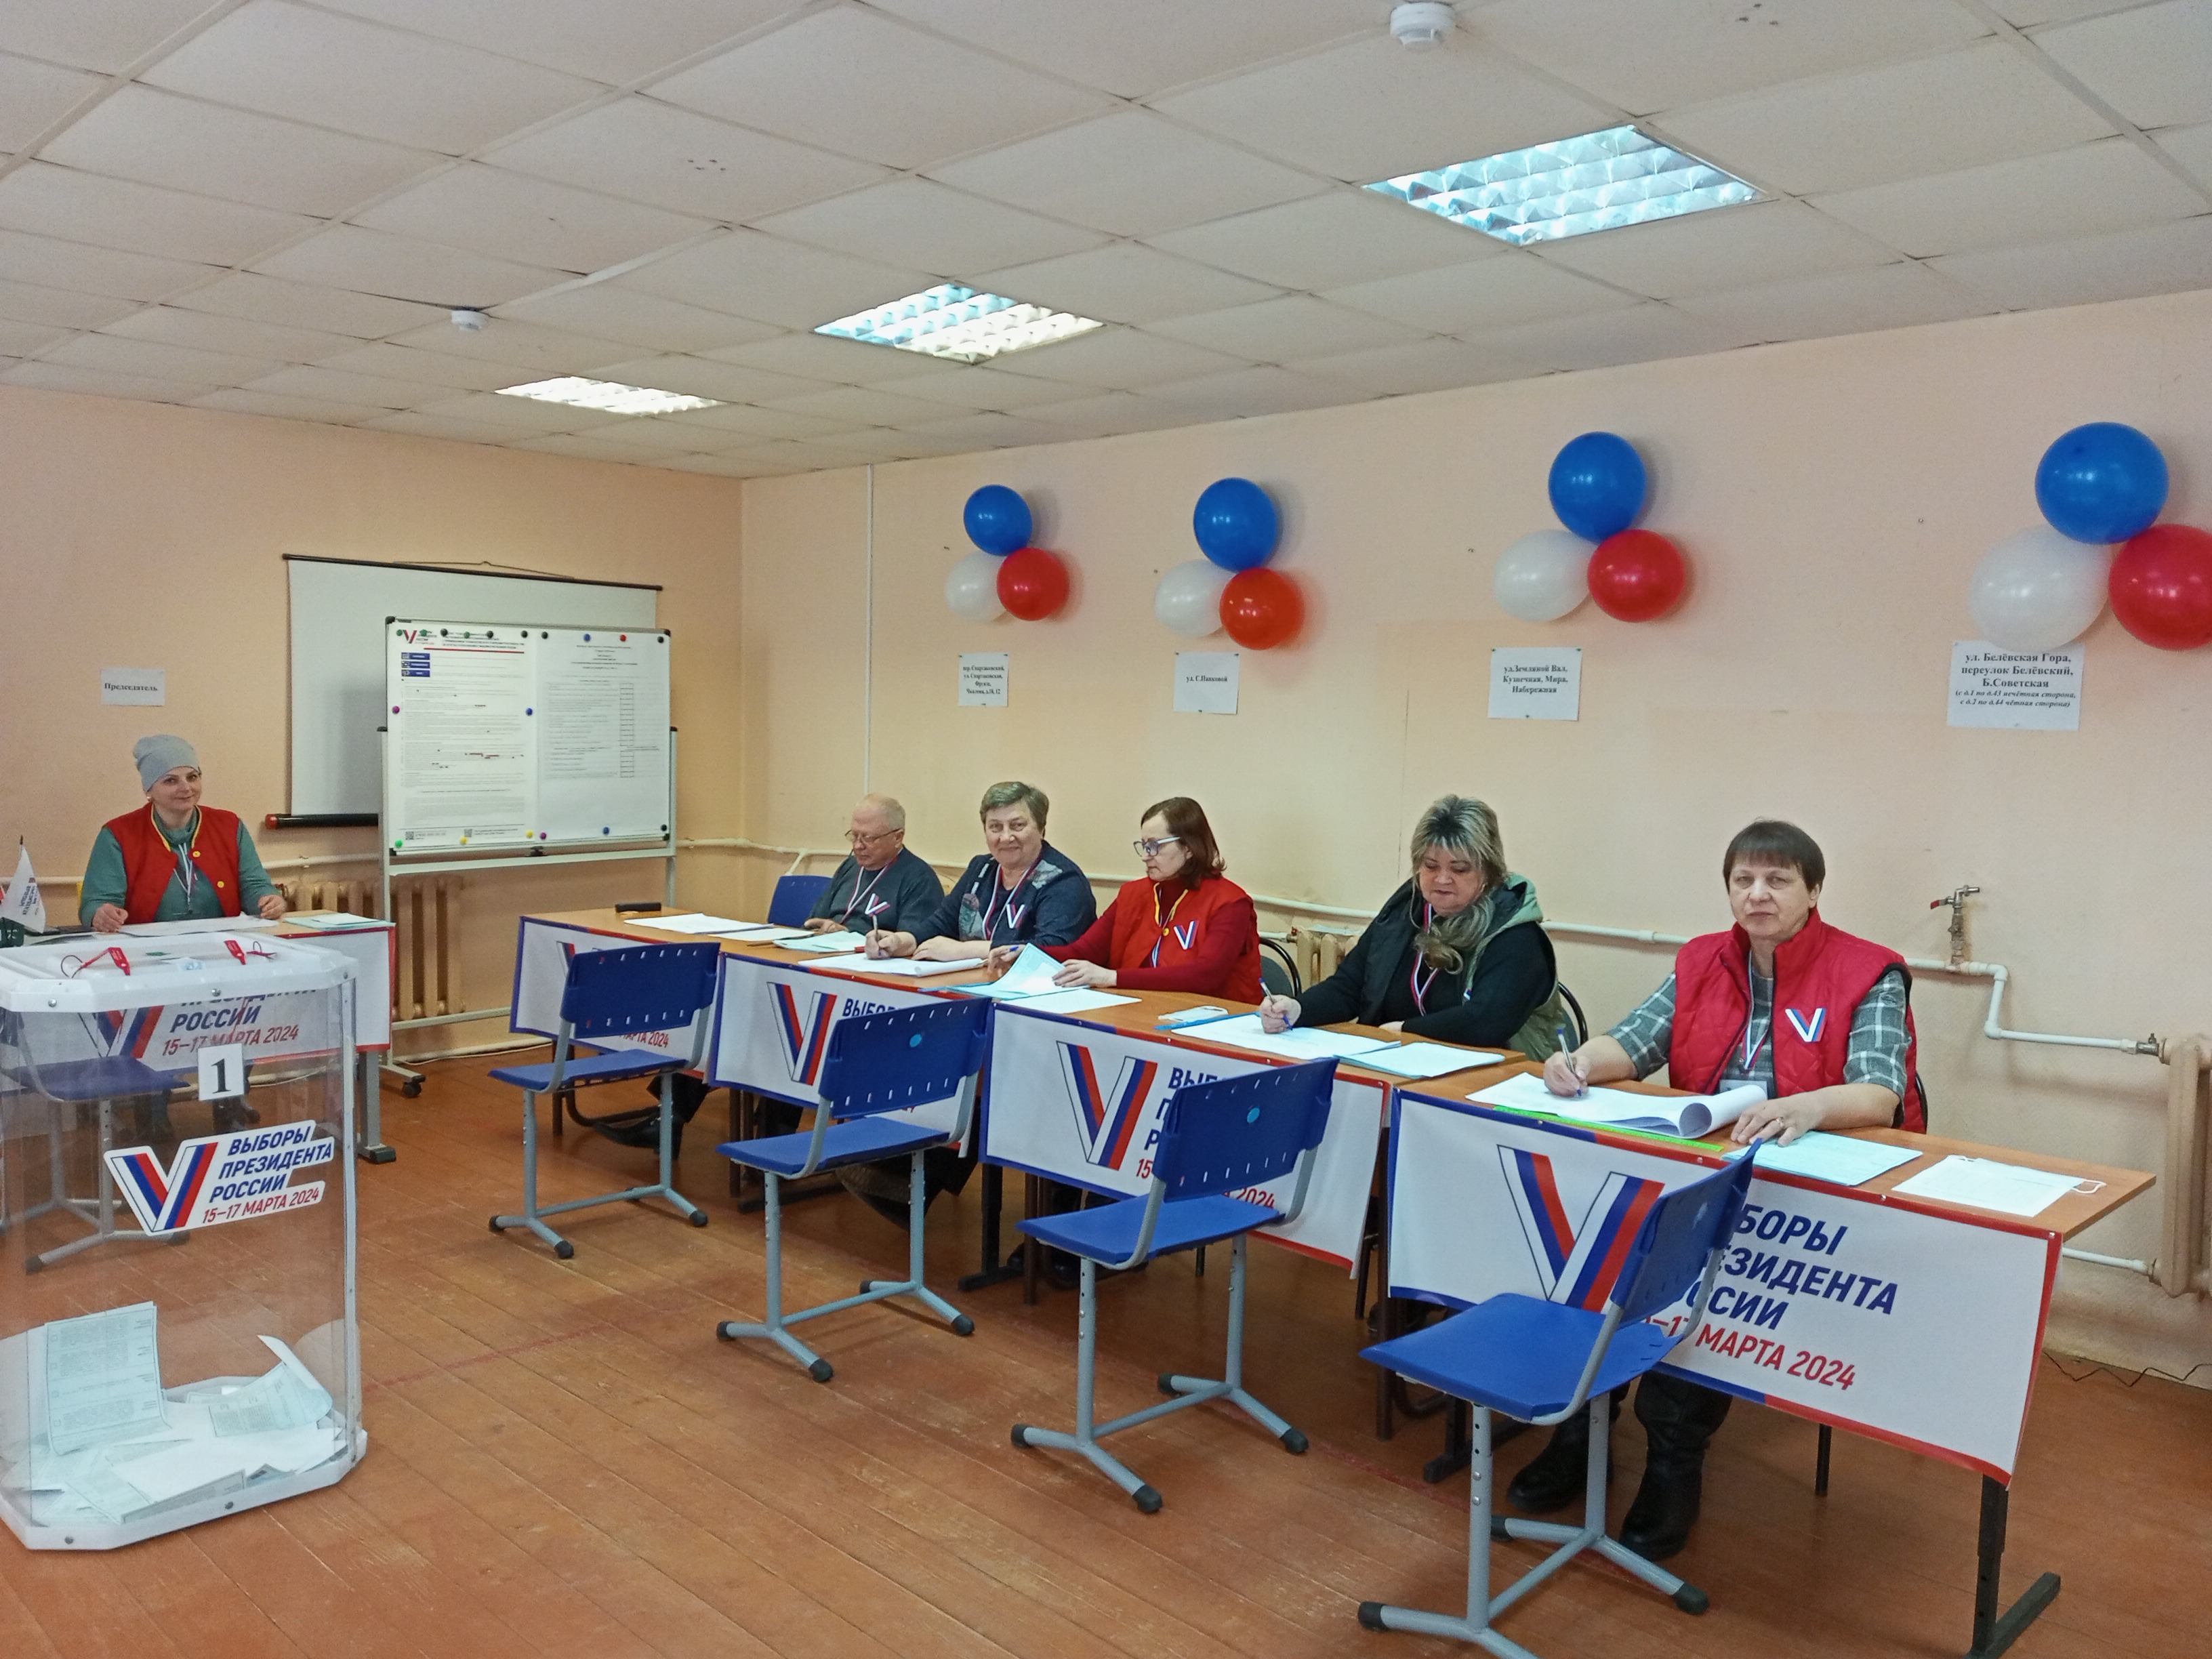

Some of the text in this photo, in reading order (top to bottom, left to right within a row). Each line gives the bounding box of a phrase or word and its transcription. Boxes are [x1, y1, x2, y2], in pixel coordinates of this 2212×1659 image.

[1961, 665, 2074, 676] переулок Белёвский,
[1965, 653, 2071, 664] ул. Белёвская Гора,
[104, 682, 158, 691] Председатель
[1512, 686, 1557, 695] Набережная
[1982, 678, 2049, 688] Б.Советская
[169, 1004, 262, 1033] РОССИИ
[211, 1058, 232, 1094] 1
[228, 1126, 311, 1156] ВЫБОРЫ
[218, 1143, 332, 1179] ПРЕЗИДЕНТА
[209, 1174, 287, 1204] РОССИИ
[241, 1198, 287, 1218] МАРТА
[288, 1187, 319, 1208] 2024
[1736, 1203, 1849, 1256] БОРЫ
[1717, 1245, 1898, 1315] ЗИДЕНТА
[1686, 1281, 1790, 1331] СИИ
[1696, 1324, 1786, 1370] МАРТА
[1787, 1351, 1856, 1391] 2024
